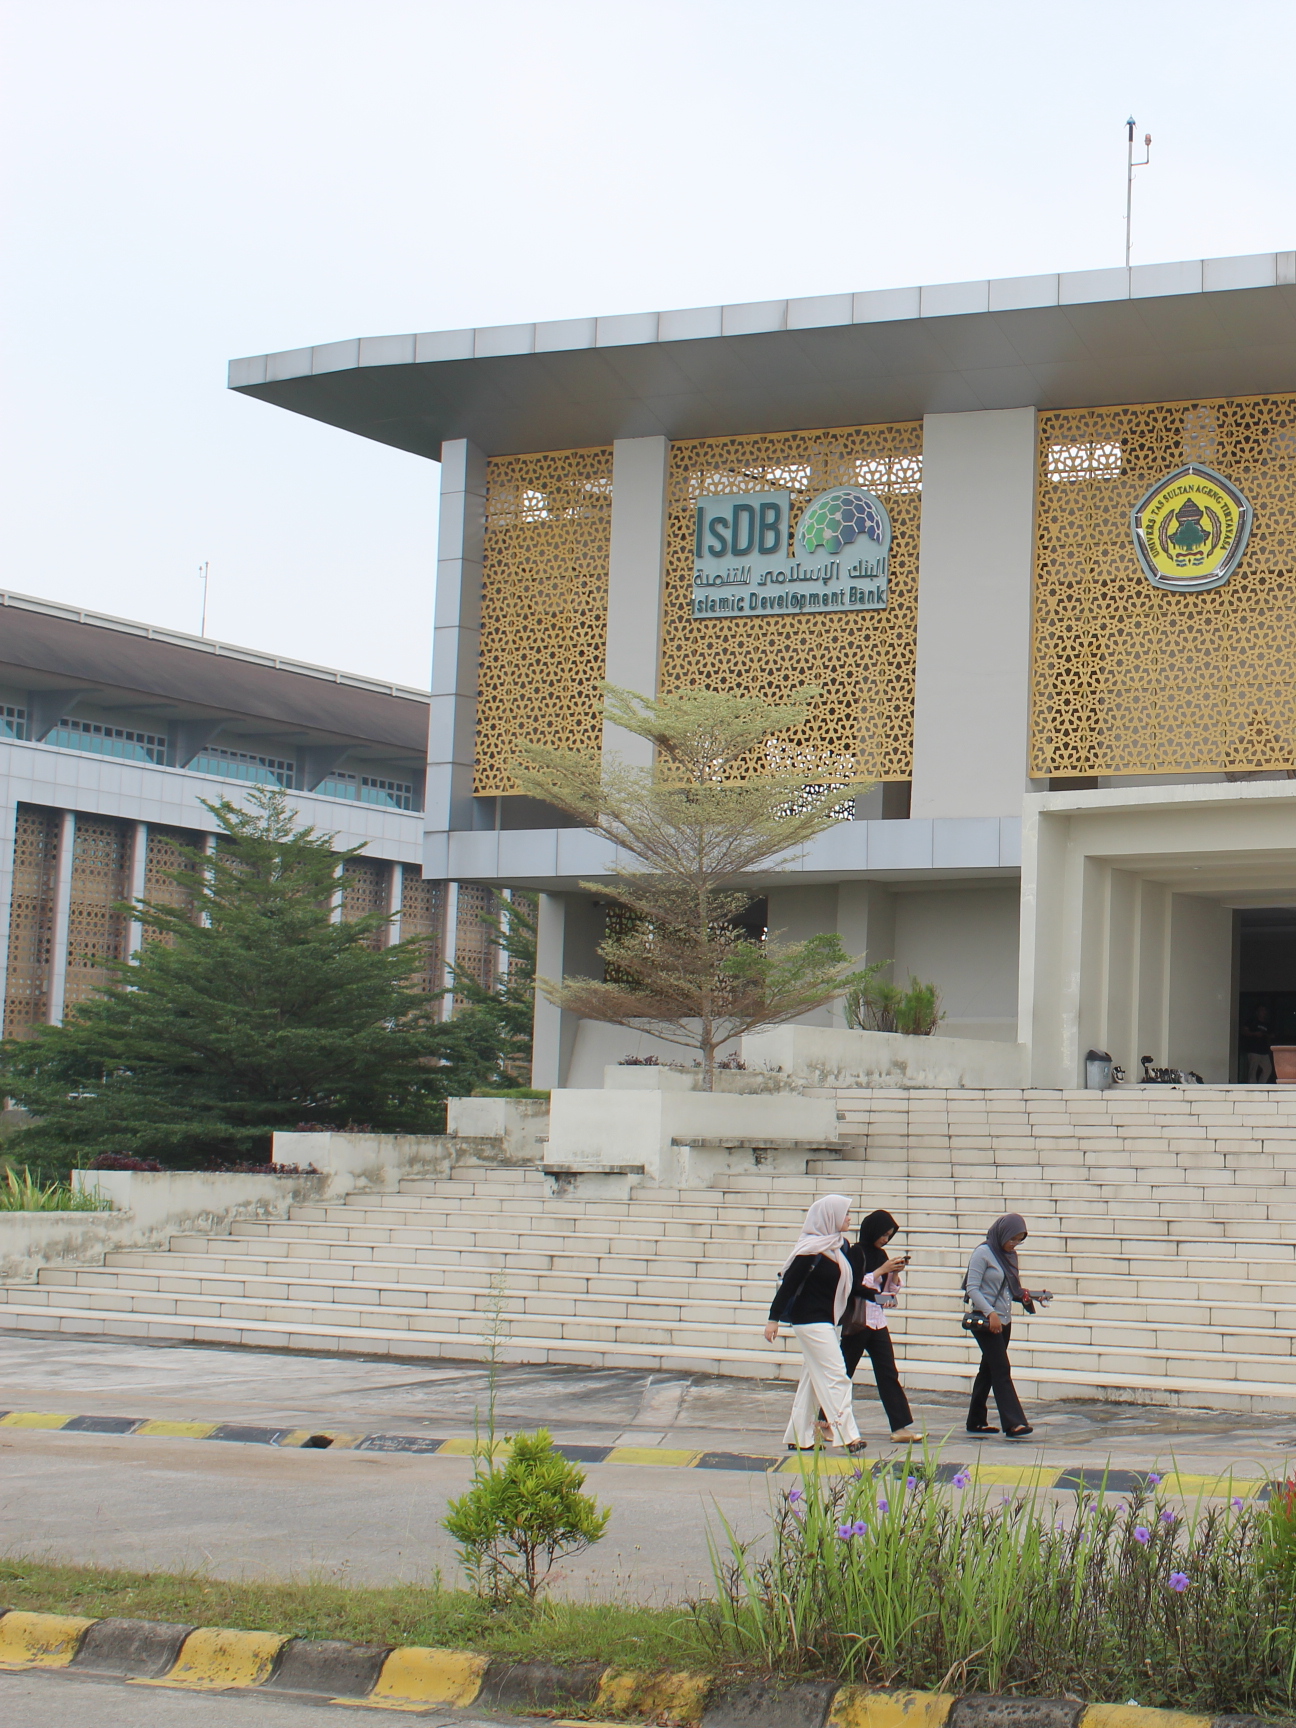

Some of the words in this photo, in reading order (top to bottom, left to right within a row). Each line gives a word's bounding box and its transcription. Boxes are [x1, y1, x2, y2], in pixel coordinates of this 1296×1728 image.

[695, 502, 783, 559] IsDB
[1145, 499, 1165, 558] UNIVERSTAS
[1162, 484, 1195, 503] SULTAN
[1195, 484, 1224, 504] AGENG
[1219, 502, 1234, 550] TIRTAYASA
[756, 559, 840, 586] الإسلامي
[847, 556, 886, 582] البنك
[691, 593, 745, 616] Islamic
[749, 586, 845, 613] Development
[848, 583, 887, 606] Bank
